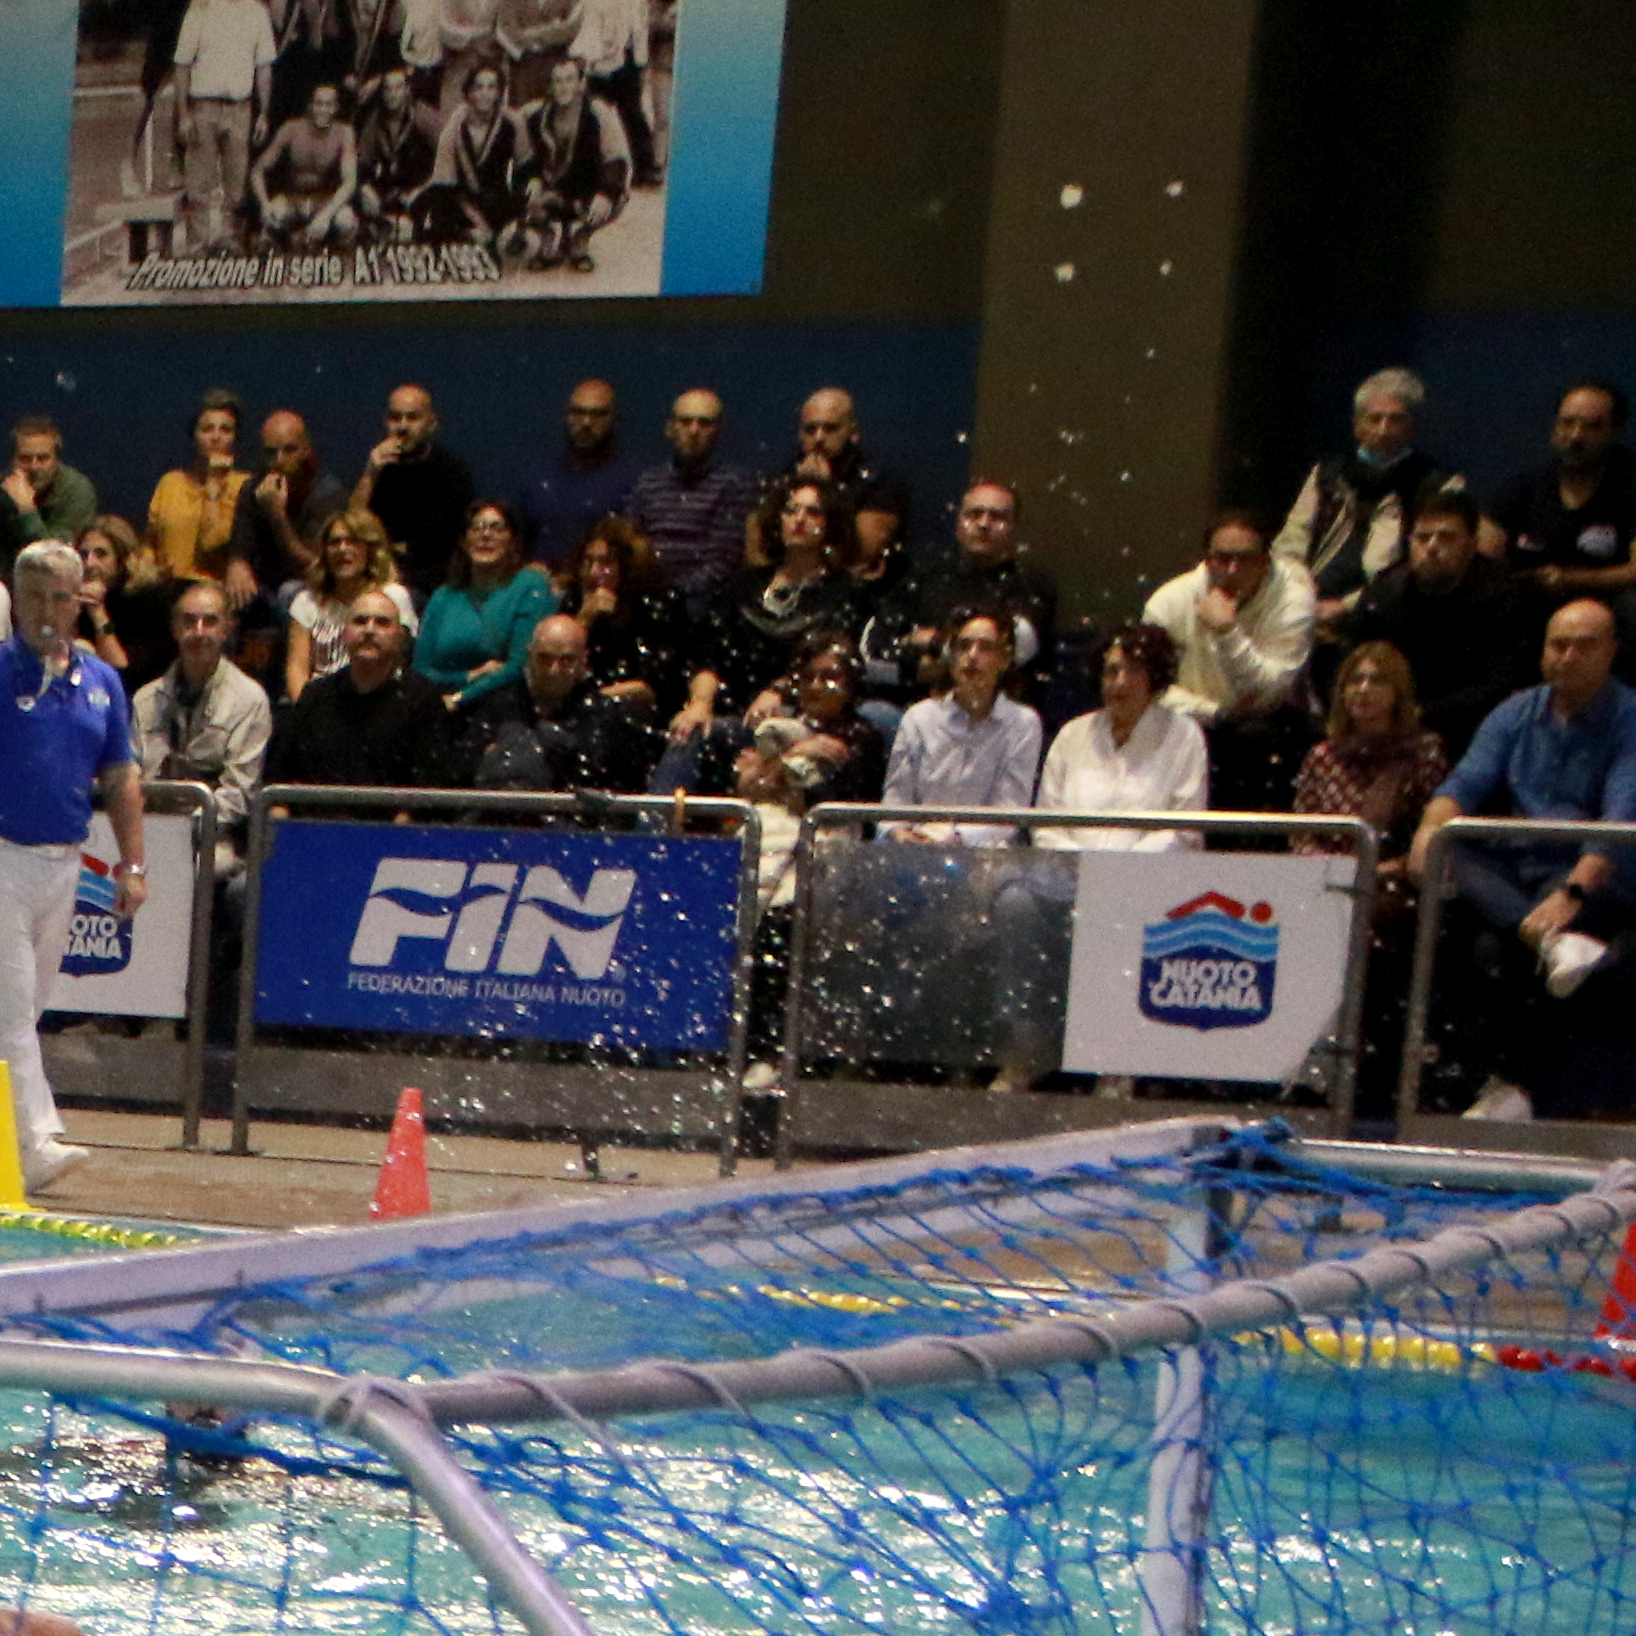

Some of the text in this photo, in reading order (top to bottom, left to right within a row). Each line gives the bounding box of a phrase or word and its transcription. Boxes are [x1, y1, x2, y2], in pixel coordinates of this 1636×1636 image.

[127, 243, 501, 291] Promozione in serie A1 1992-1993
[349, 857, 638, 981] FIN
[347, 970, 627, 1008] FEDERAZIONE ITALIANA NUOTO
[1160, 957, 1258, 988] NUOTO
[1148, 980, 1263, 1011] CATANIA
